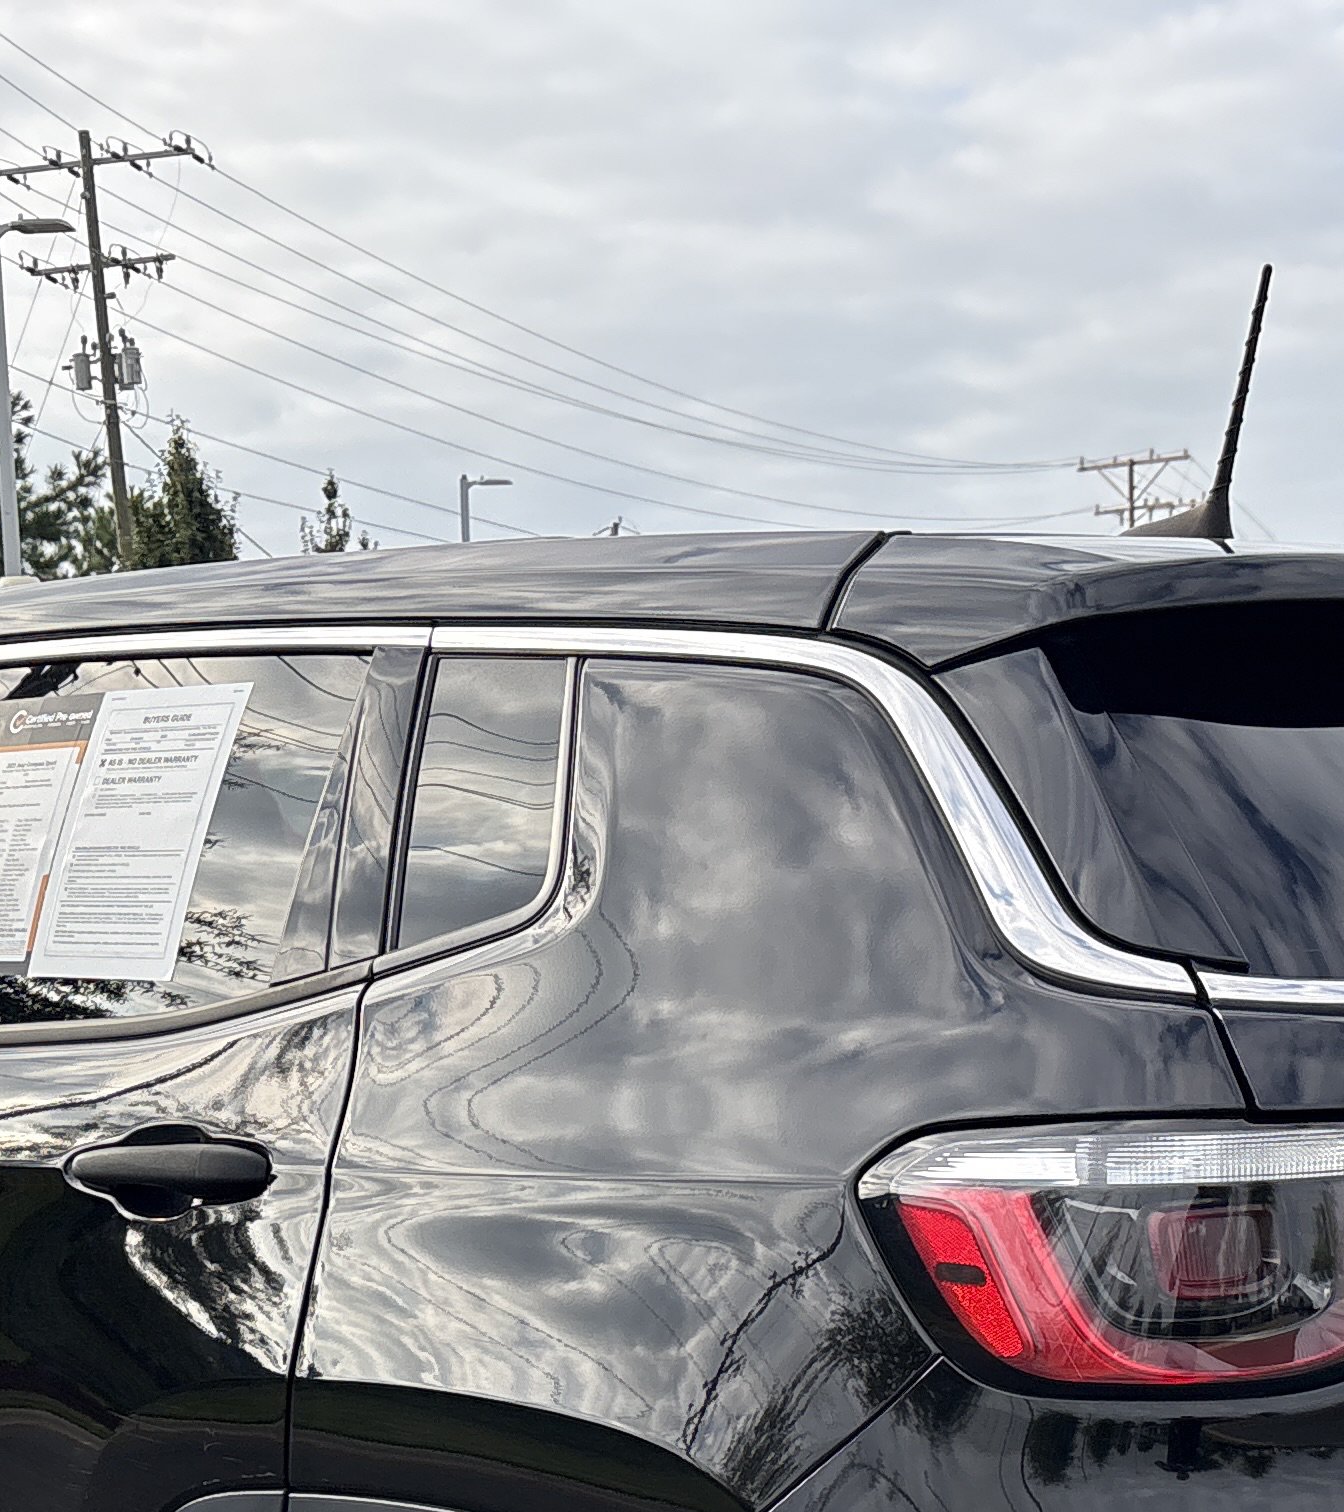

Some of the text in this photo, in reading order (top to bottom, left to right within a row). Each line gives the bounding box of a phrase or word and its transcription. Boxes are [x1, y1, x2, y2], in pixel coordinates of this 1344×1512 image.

[142, 713, 193, 724] BUYERS GUIDE
[137, 756, 163, 766] DEALER
[163, 755, 200, 764] WARRANTY
[101, 775, 163, 786] DEALER WARRANTY
